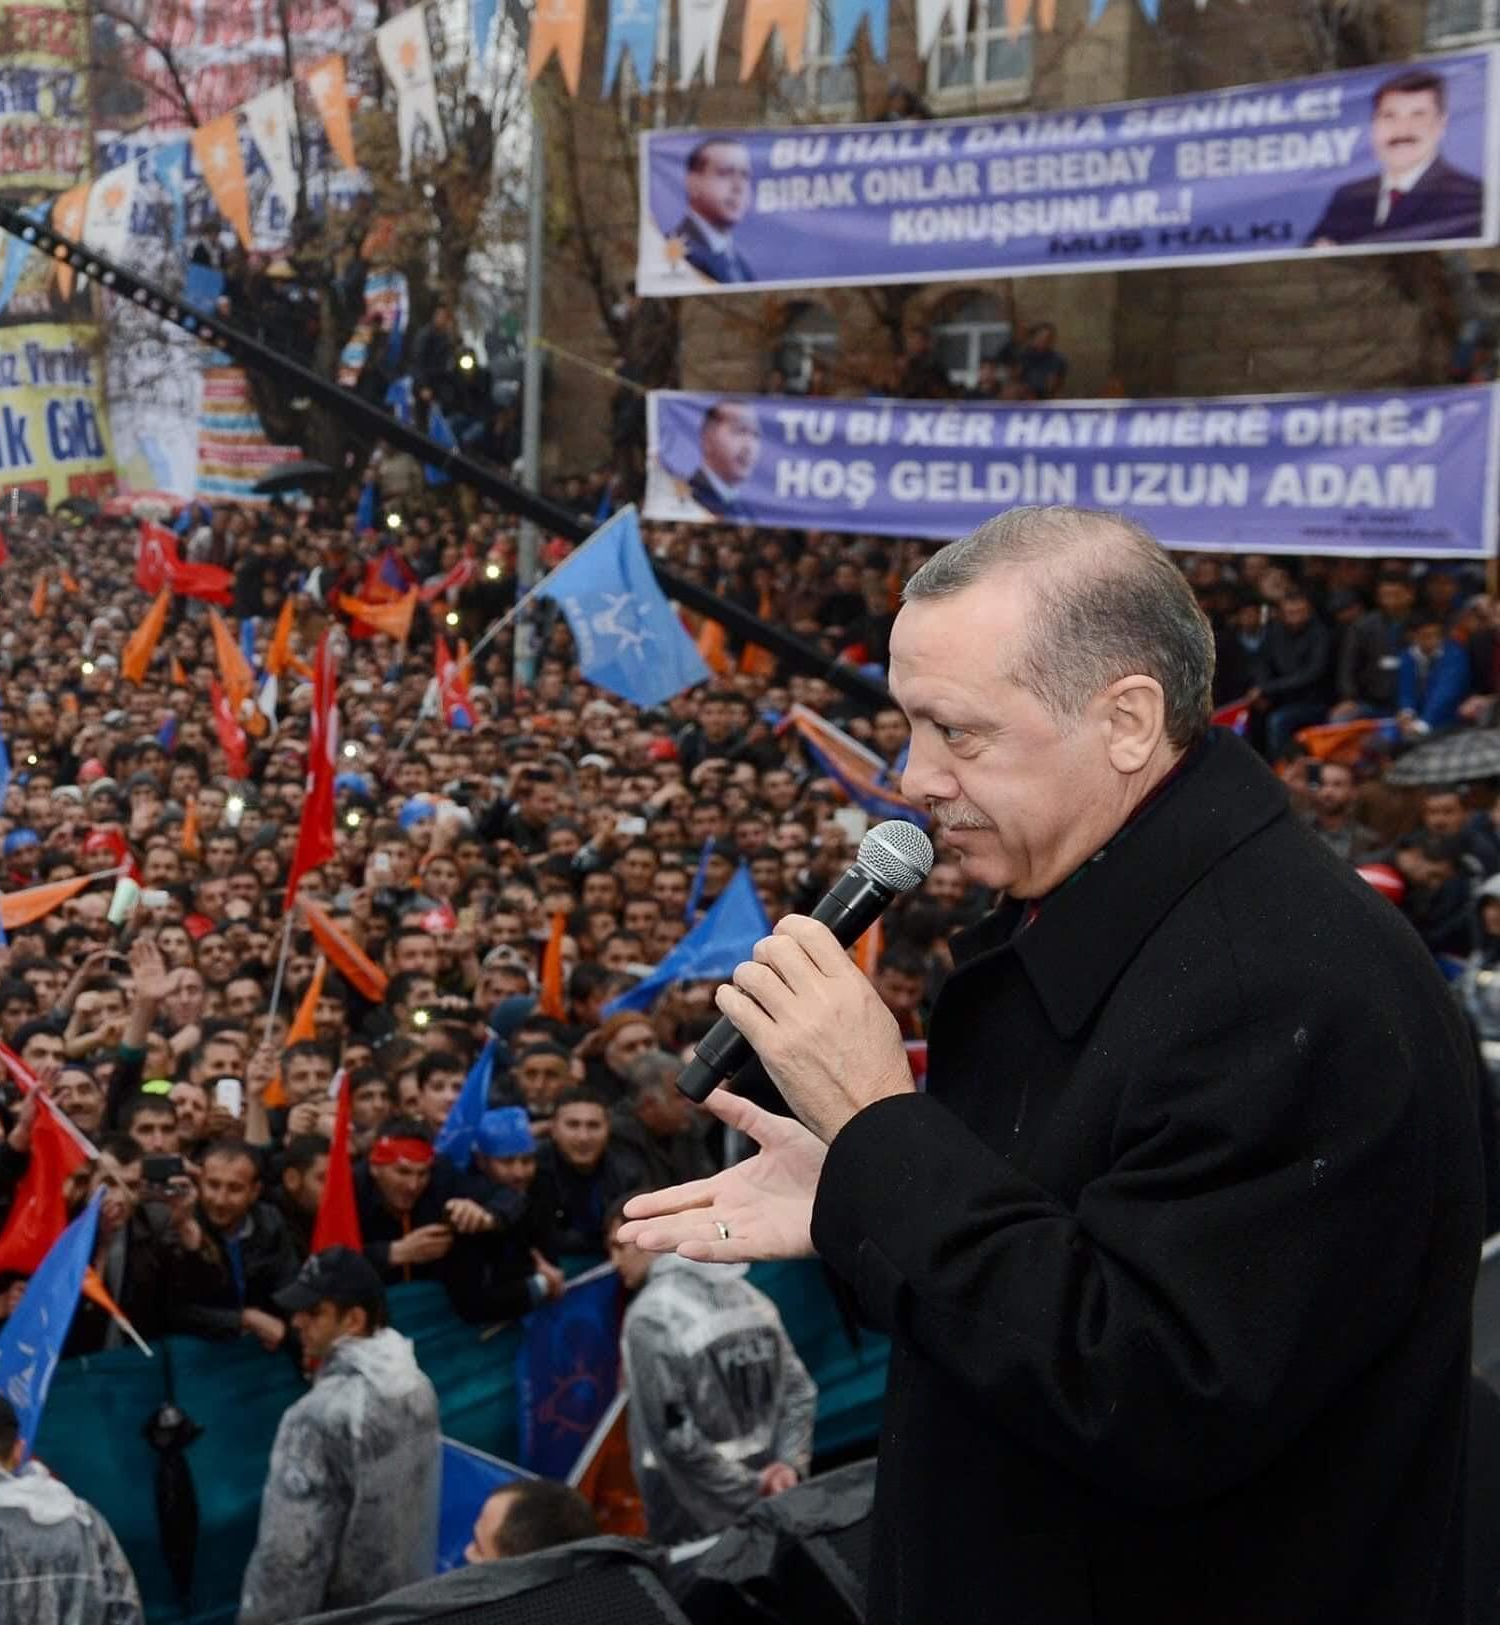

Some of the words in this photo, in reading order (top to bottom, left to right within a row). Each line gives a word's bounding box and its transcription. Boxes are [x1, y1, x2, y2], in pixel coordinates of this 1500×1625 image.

[769, 137, 830, 169] BU
[835, 127, 955, 164] HALK
[1117, 86, 1343, 141] SENİNLE!
[755, 172, 856, 213] BIRAK
[862, 160, 980, 205] ONLAR
[987, 143, 1155, 196] BEREDAY
[1176, 126, 1363, 179] BEREDAY
[778, 410, 835, 444] TU
[902, 404, 995, 447] XÊR
[775, 459, 876, 510] HOŞ
[887, 454, 1076, 504] GELDİN
[1092, 463, 1249, 506] UZUN
[1262, 463, 1436, 508] ADAM
